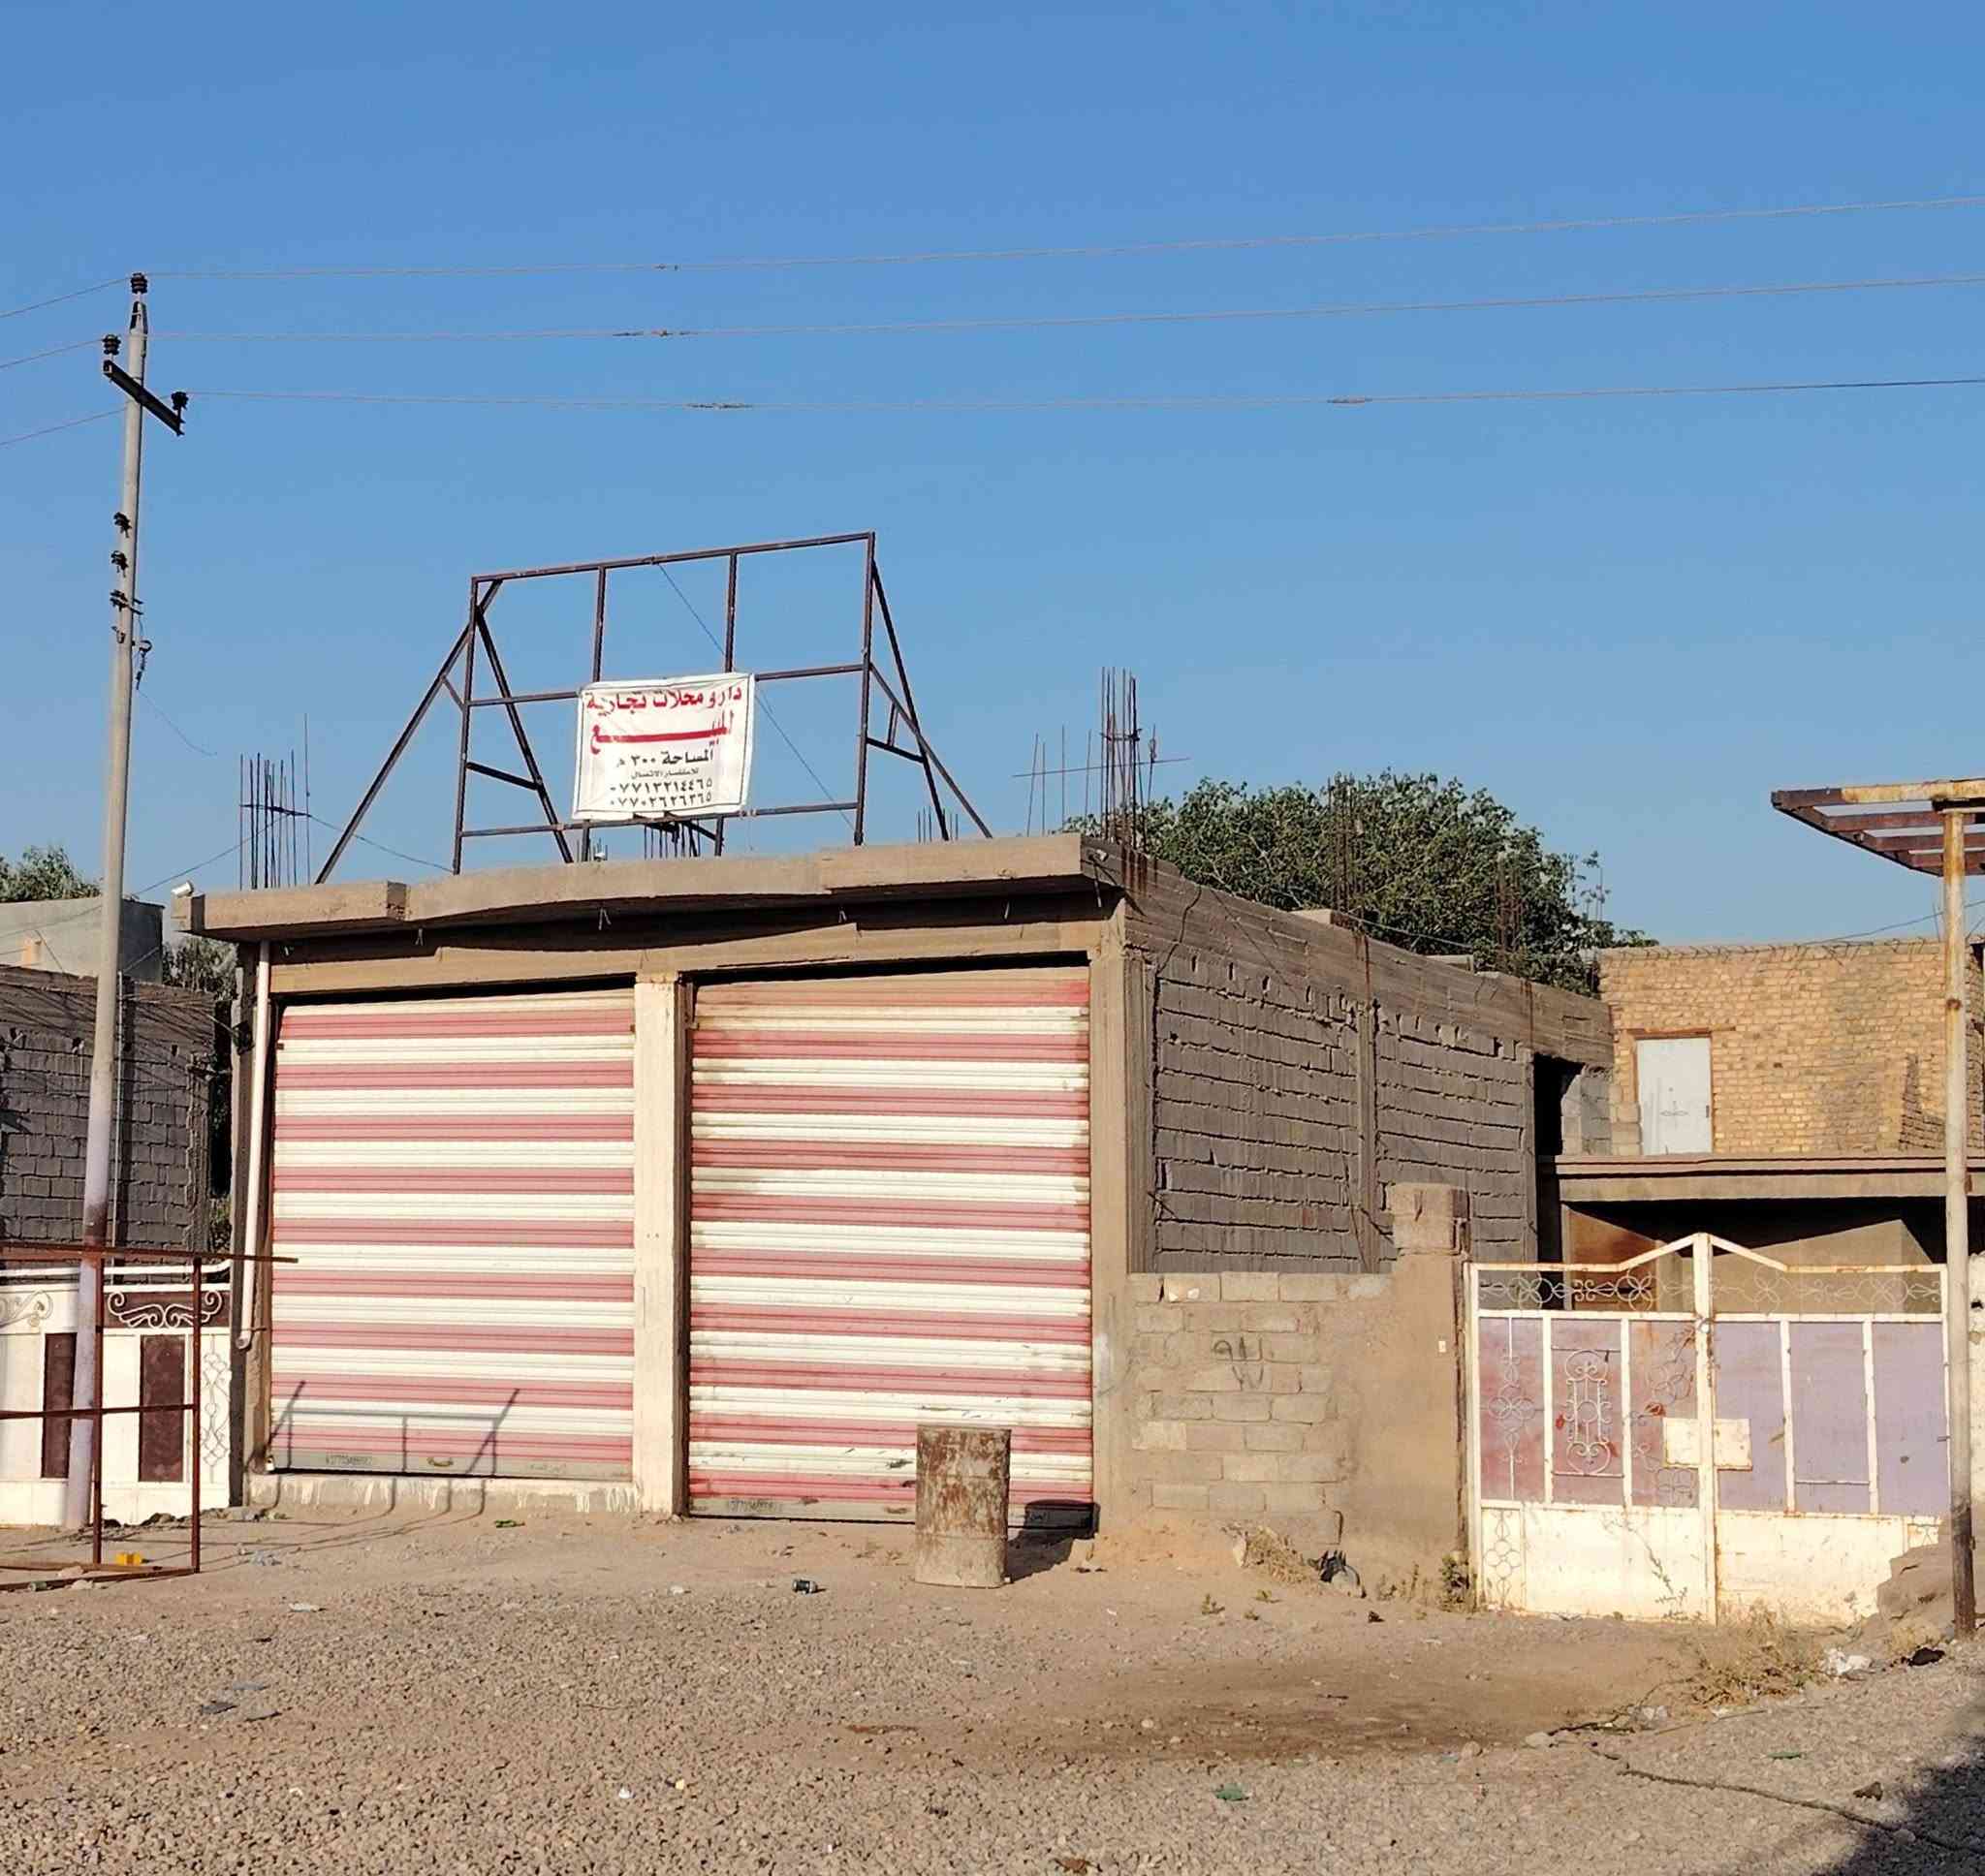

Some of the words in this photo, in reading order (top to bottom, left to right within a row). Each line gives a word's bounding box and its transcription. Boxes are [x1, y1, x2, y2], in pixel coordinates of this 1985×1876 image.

[586, 691, 647, 716] تجارية
[652, 689, 704, 708] محلات
[590, 709, 735, 755] للبيع
[661, 749, 713, 765] المساحة
